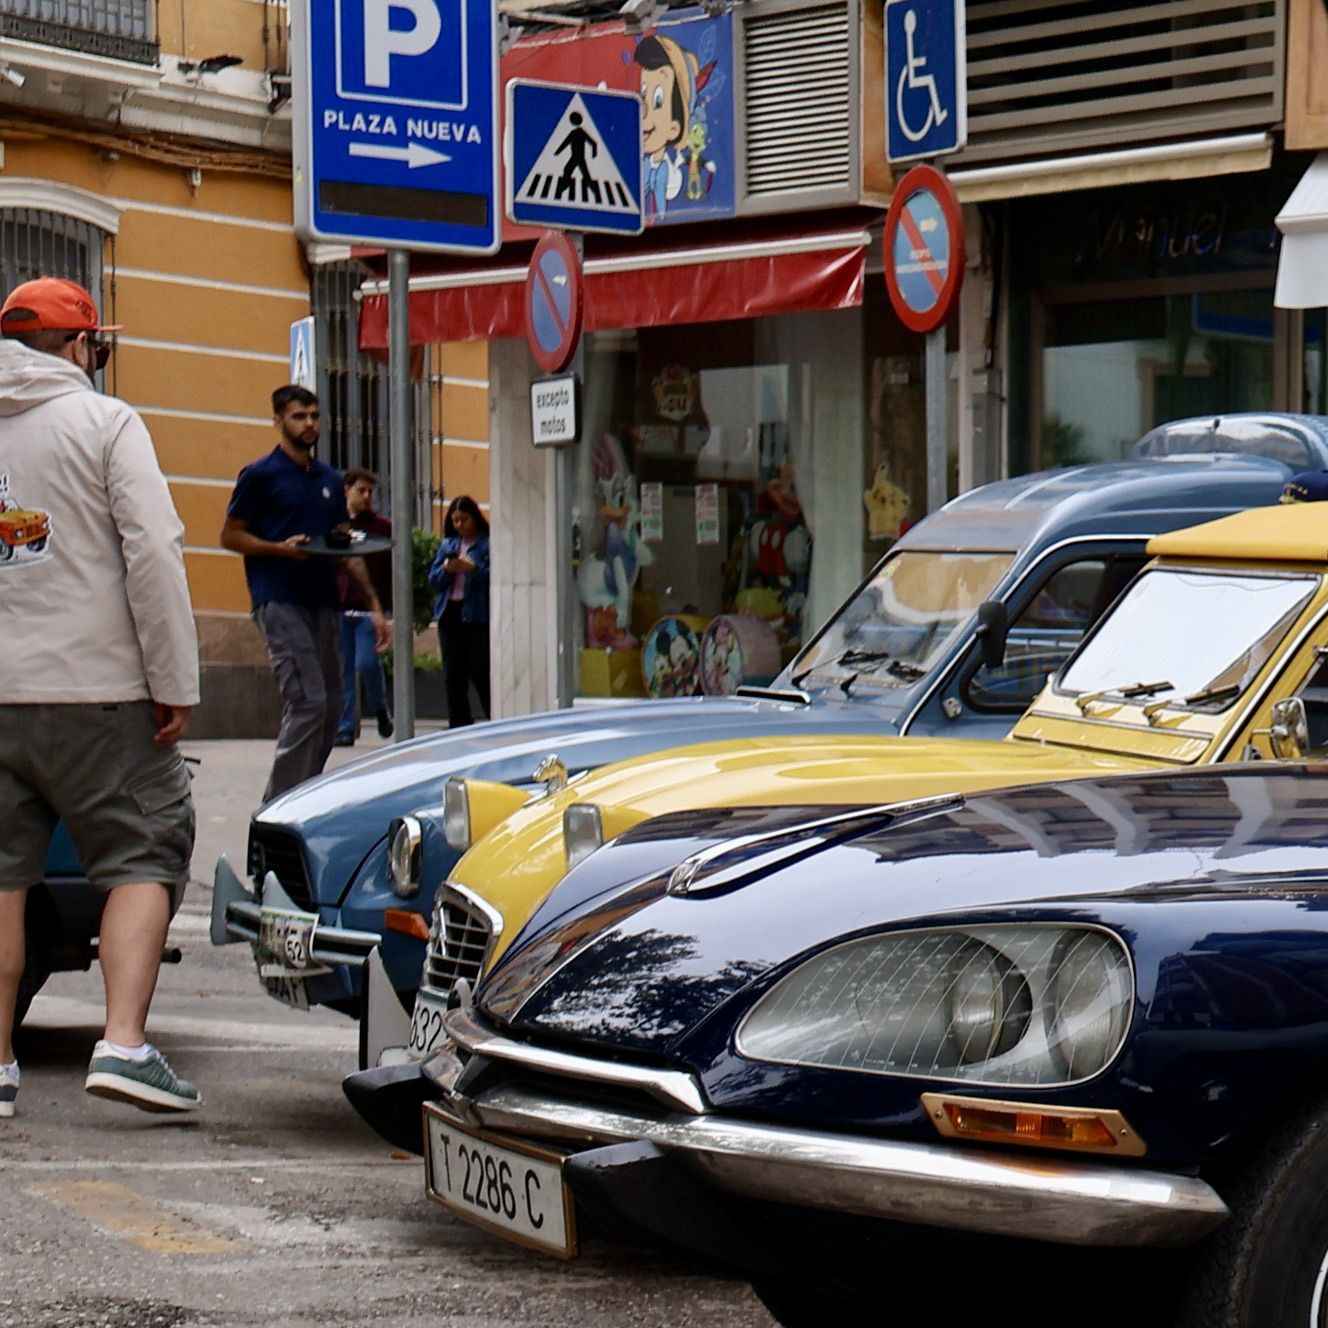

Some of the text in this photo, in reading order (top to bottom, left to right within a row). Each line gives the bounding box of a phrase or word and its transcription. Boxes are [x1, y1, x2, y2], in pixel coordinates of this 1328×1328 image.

[364, 0, 442, 88] P
[323, 109, 481, 144] PLAZA NUEVA
[440, 1133, 544, 1230] T 2286 C
